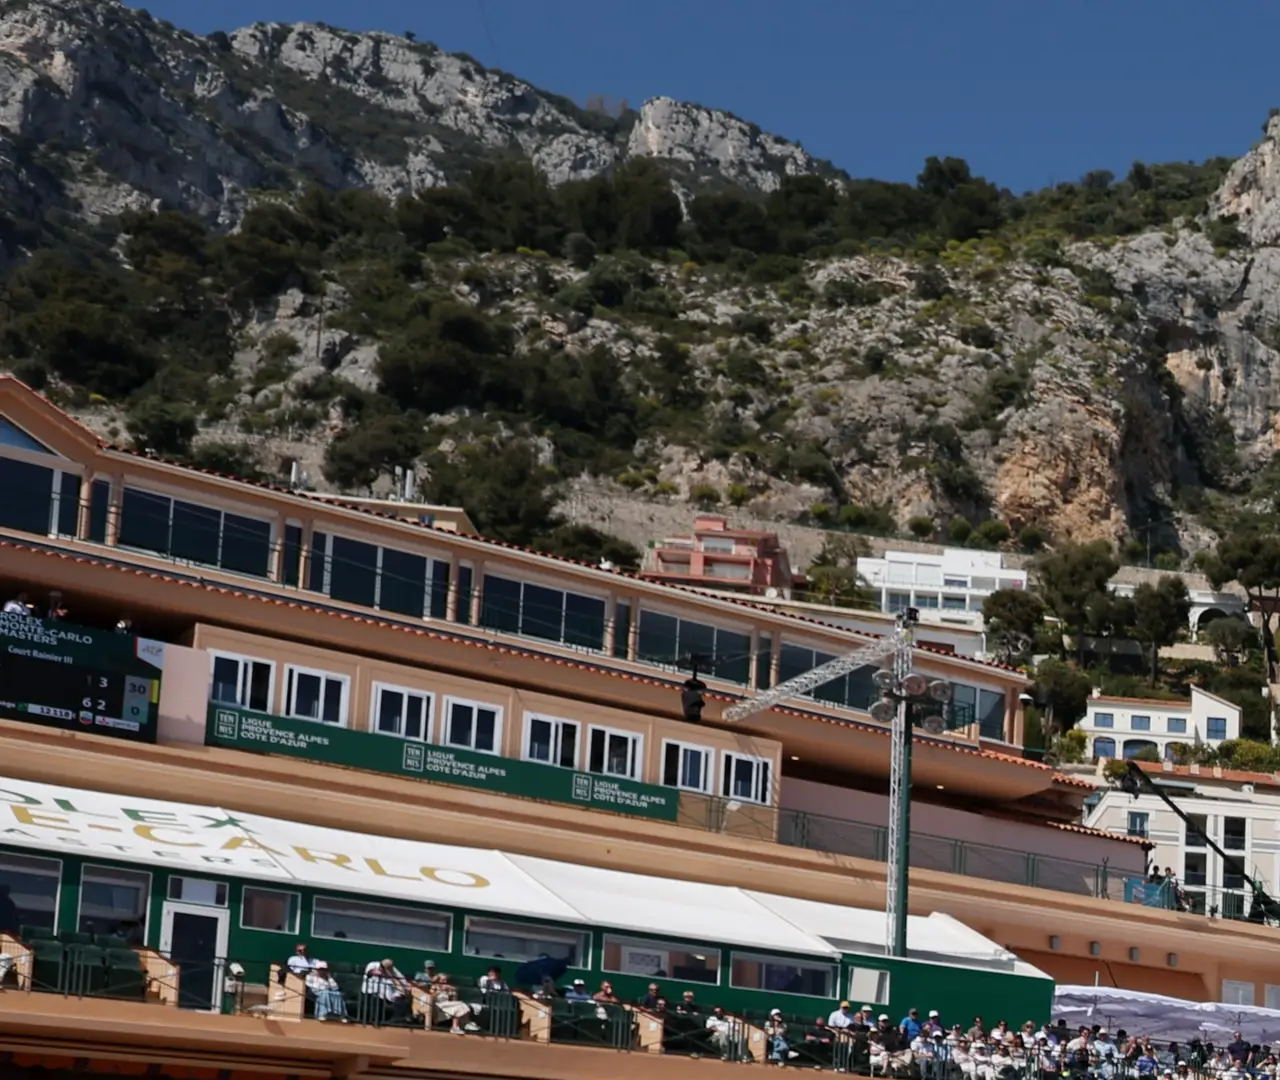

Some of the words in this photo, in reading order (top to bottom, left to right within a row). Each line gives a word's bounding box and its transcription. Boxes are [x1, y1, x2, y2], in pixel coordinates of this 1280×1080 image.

[0, 612, 42, 626] ROLEX
[0, 620, 92, 644] MONTE-CARLO
[0, 628, 58, 646] MASTERS
[8, 645, 31, 656] Court
[99, 677, 108, 688] 3
[128, 683, 146, 695] 30
[82, 697, 92, 707] 6
[97, 700, 106, 710] 2
[131, 706, 140, 716] 0
[242, 717, 272, 729] LIGUE
[241, 724, 295, 739] PROVENCE
[298, 733, 329, 745] ALPES
[270, 736, 307, 749] D'AZUR
[427, 750, 455, 761] LIGUE
[427, 757, 475, 771] PROVENCE
[477, 765, 506, 777] ALPES
